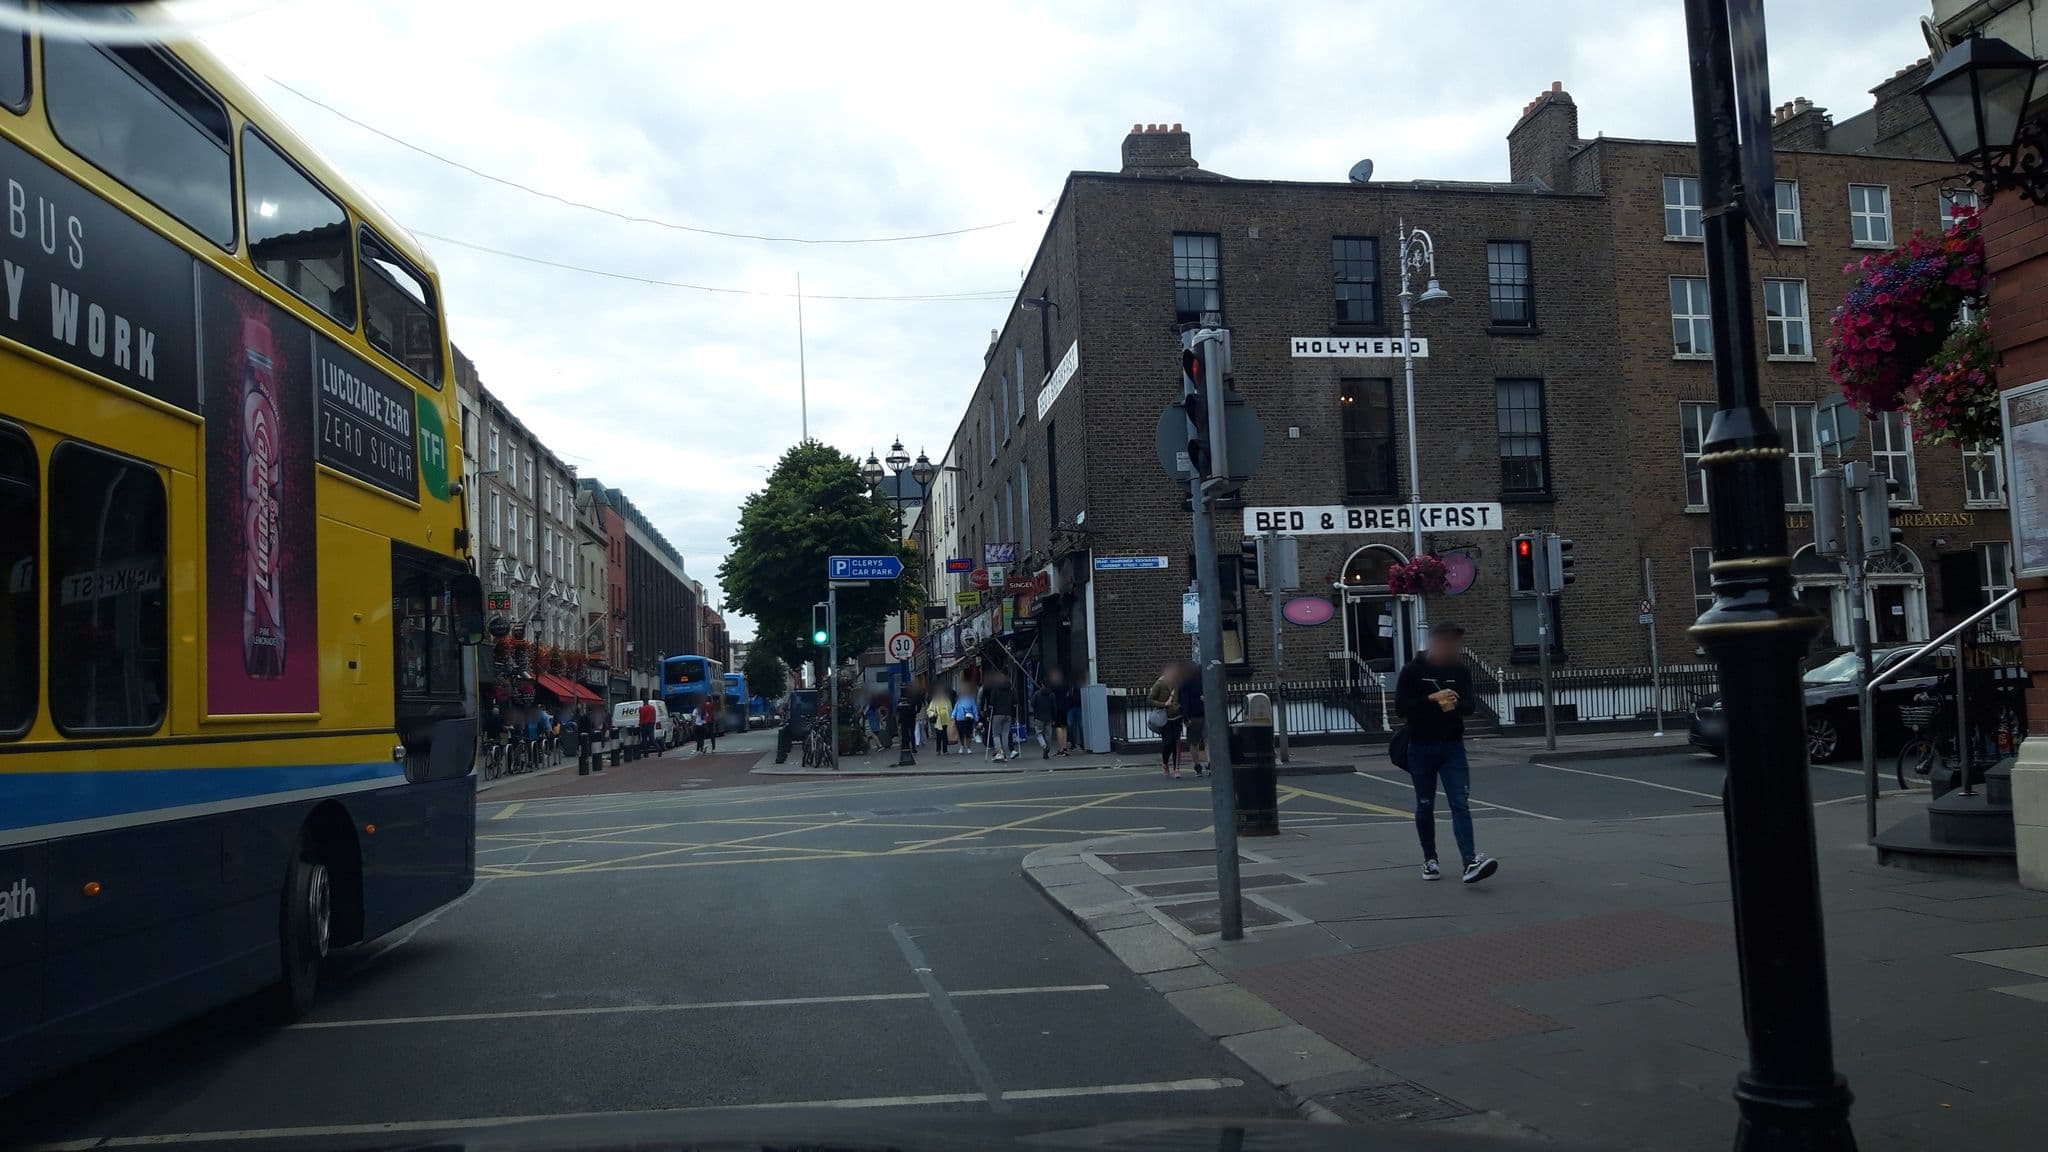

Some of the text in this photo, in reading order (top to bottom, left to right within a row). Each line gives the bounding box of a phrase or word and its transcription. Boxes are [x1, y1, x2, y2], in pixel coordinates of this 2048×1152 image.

[9, 178, 83, 270] BUS
[51, 282, 156, 382] WORK
[1295, 341, 1420, 354] HOLYHEAD
[322, 358, 382, 422] LUCOZADE
[383, 396, 410, 437] ZERO
[324, 411, 362, 457] ZERO
[371, 436, 412, 481] SUGAR
[421, 427, 445, 470] TFI
[1256, 506, 1490, 531] BED & BREAKFAST
[1895, 512, 1976, 527] BREAKFAST
[836, 561, 847, 575] P
[896, 639, 910, 651] 30
[622, 705, 641, 717] Her
